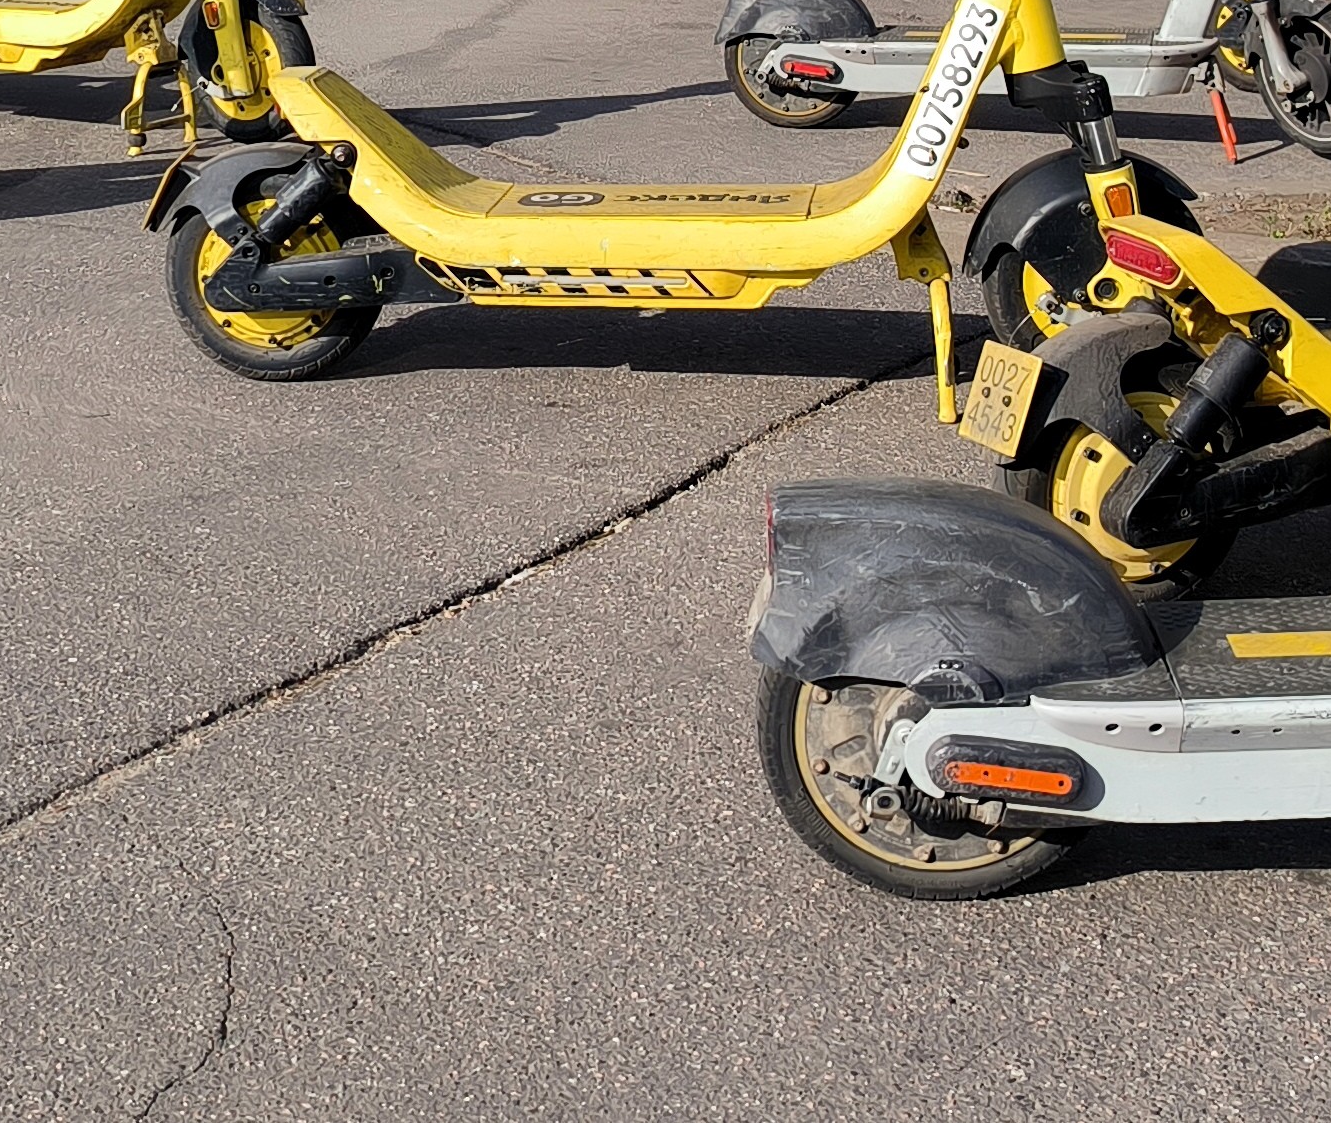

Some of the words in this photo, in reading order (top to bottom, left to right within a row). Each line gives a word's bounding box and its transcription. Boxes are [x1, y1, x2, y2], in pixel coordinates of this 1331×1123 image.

[906, 2, 998, 167] 00758293
[980, 355, 1033, 396] 0027
[968, 400, 1017, 443] 4543
